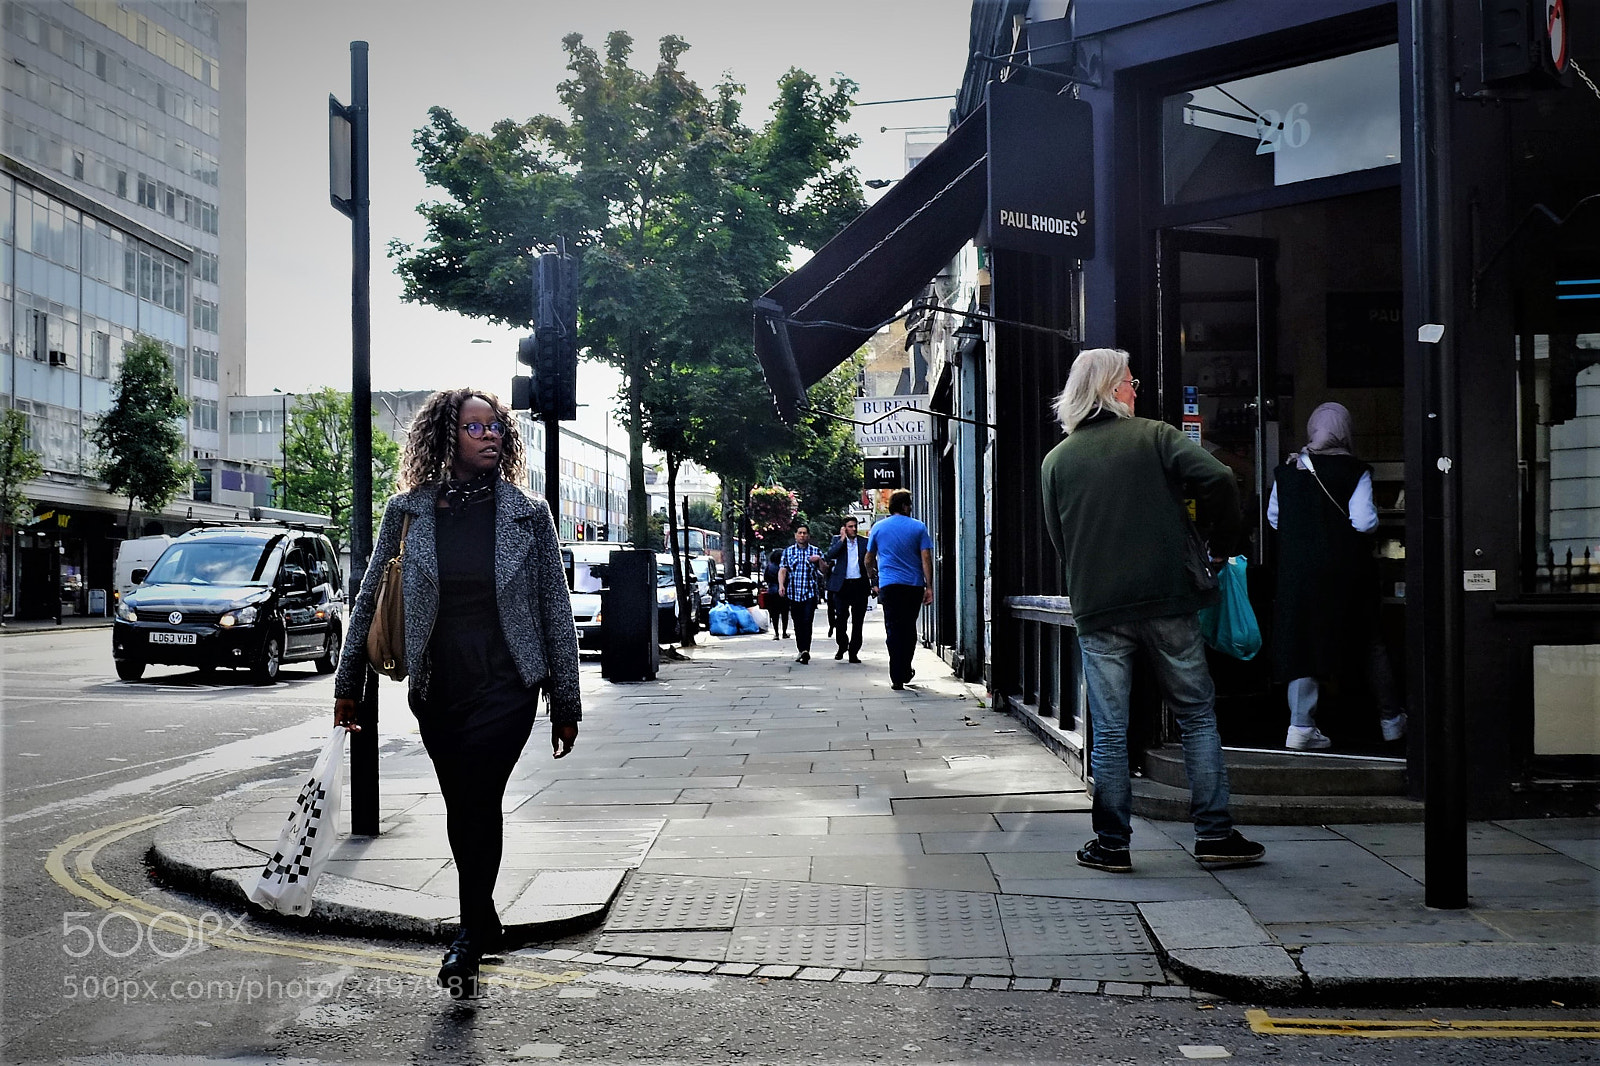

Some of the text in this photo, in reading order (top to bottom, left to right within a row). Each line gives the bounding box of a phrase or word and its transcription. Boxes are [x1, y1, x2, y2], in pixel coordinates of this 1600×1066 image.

[1255, 102, 1311, 156] 26
[863, 399, 923, 415] BUREAU
[887, 413, 898, 421] DE
[862, 420, 926, 435] CHANGE
[860, 434, 928, 444] CAMBIO WECHSEL
[873, 468, 895, 479] Mm
[153, 633, 194, 643] LD63 VHB
